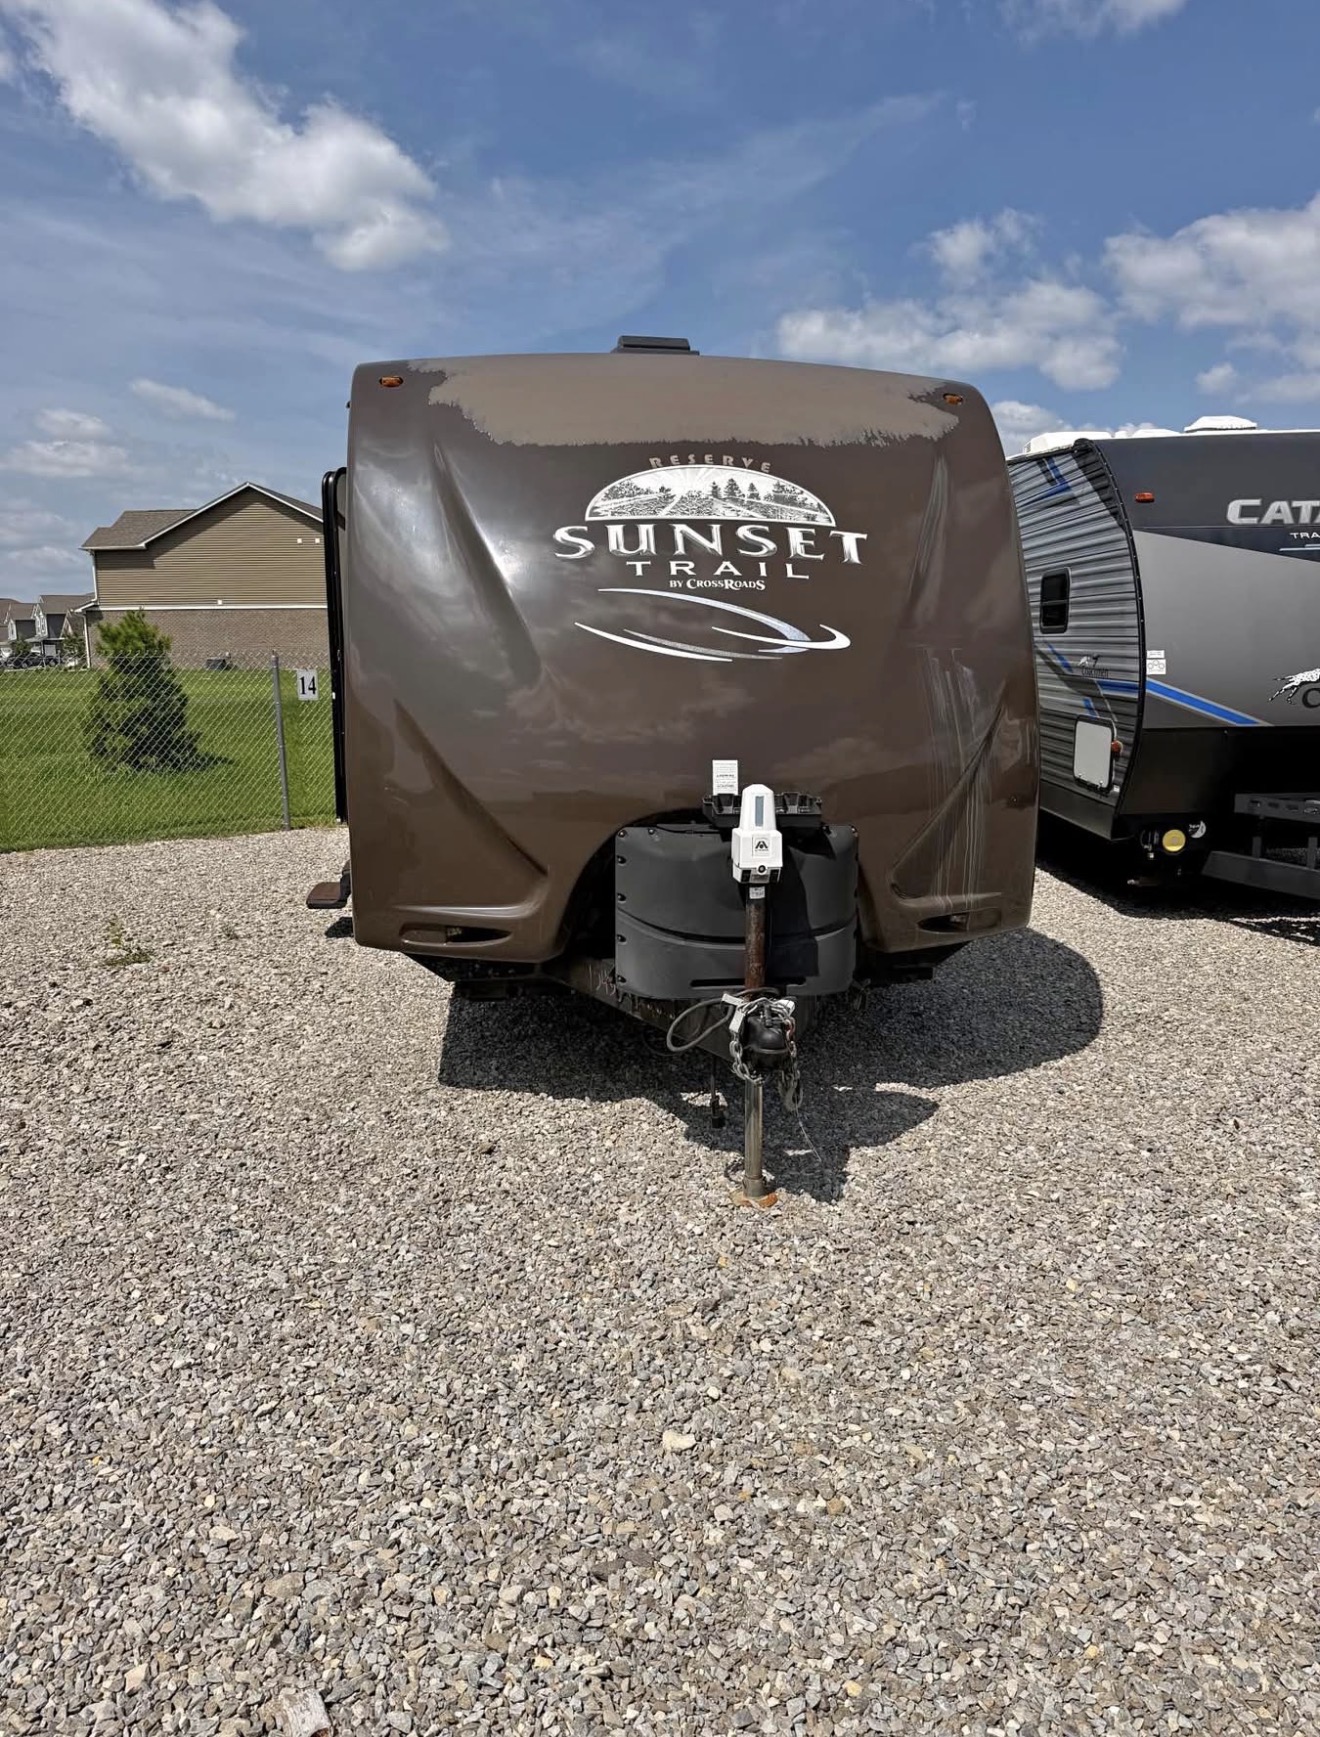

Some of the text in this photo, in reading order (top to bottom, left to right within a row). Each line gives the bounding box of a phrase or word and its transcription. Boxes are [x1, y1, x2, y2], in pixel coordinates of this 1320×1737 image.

[648, 453, 771, 473] RESERVE
[1226, 499, 1320, 525] CAT
[552, 523, 868, 565] SUNSET
[626, 560, 810, 580] TRAIL
[669, 579, 683, 588] BY
[300, 676, 317, 695] 14
